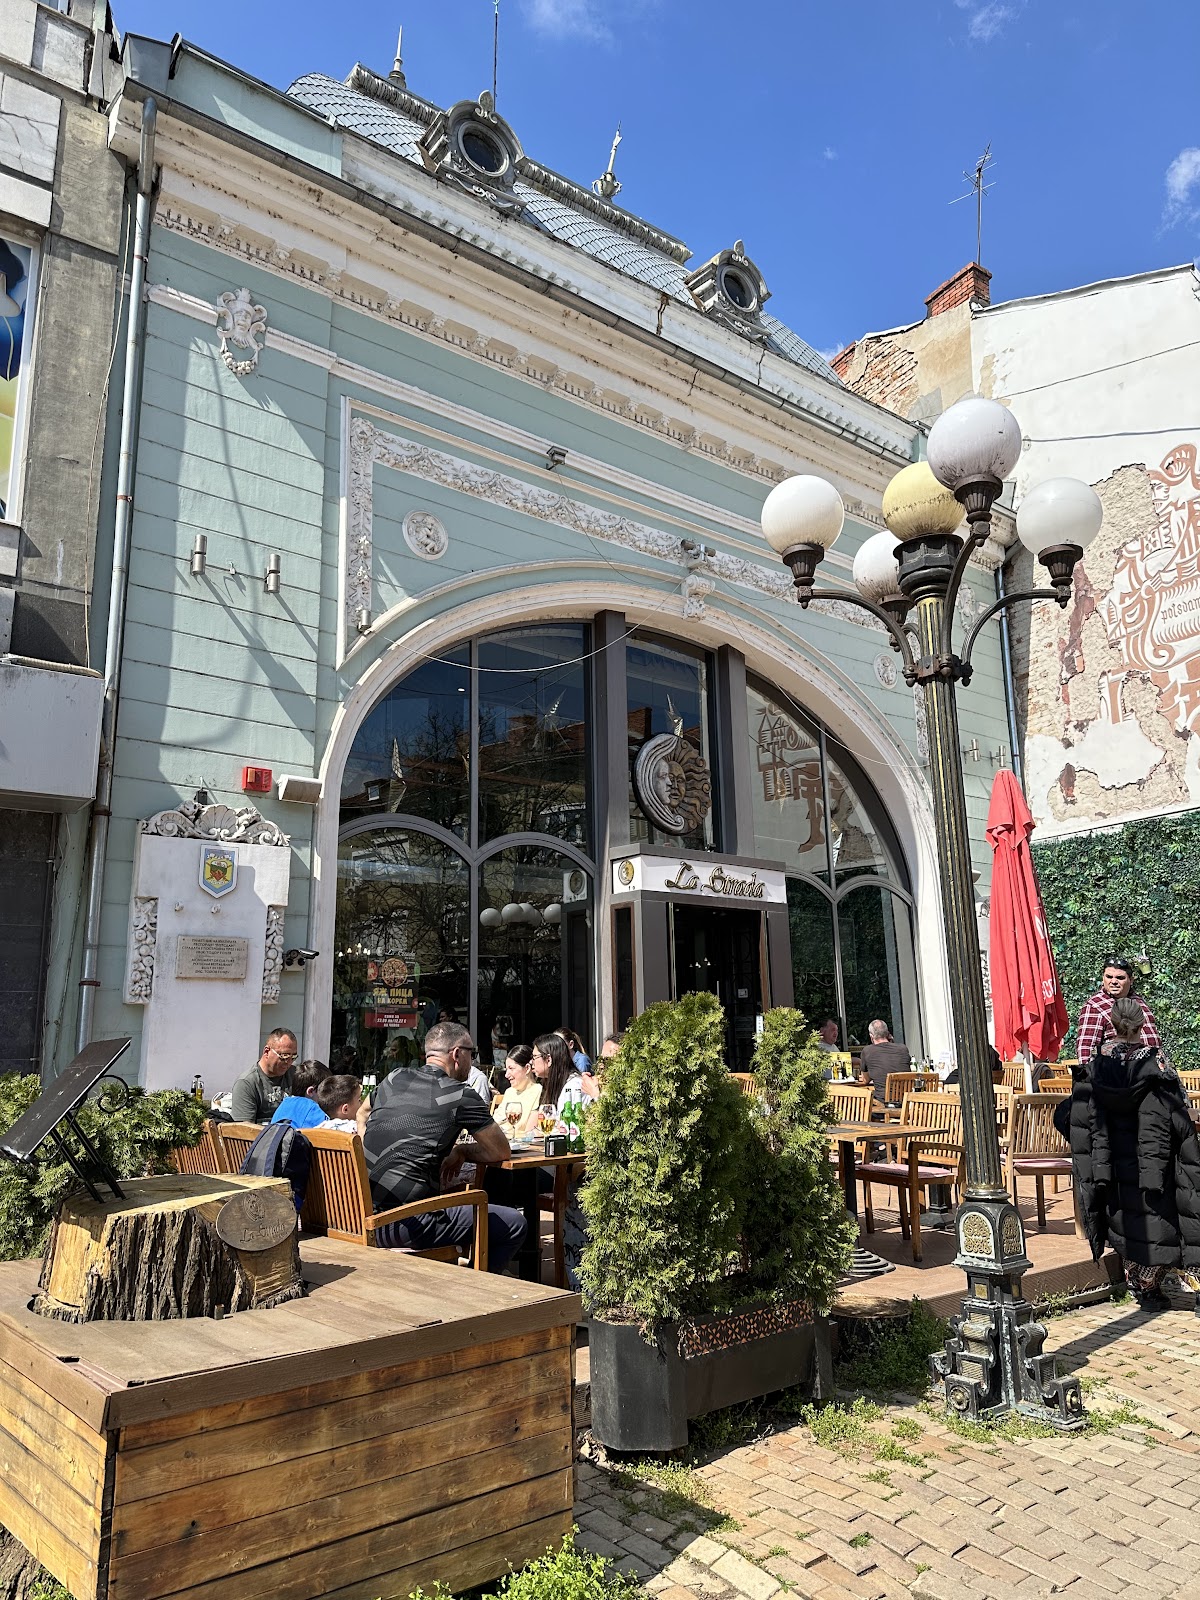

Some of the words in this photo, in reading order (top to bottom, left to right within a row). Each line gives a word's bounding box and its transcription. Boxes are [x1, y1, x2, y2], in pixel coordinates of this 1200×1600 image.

[664, 861, 699, 890] La
[700, 866, 766, 898] Strada
[390, 988, 413, 997] ПИЦА
